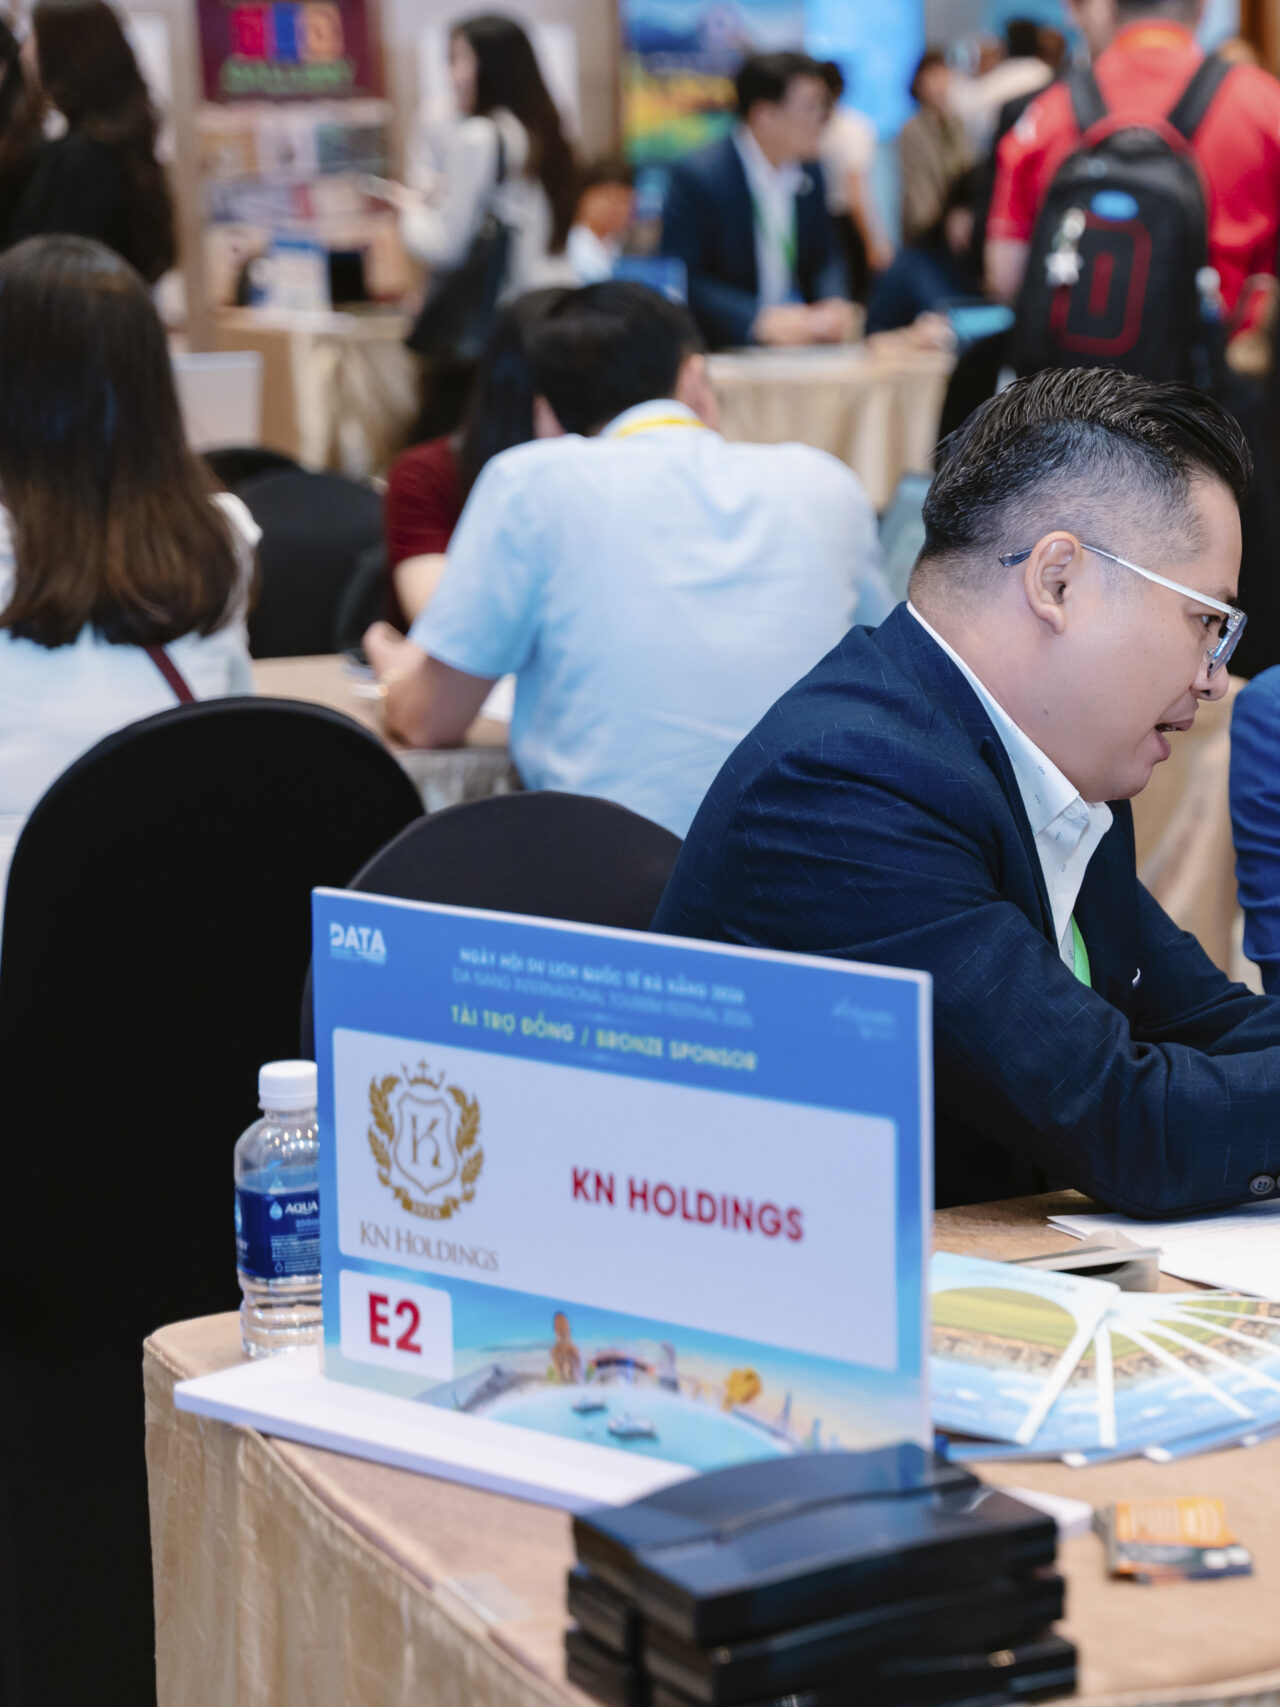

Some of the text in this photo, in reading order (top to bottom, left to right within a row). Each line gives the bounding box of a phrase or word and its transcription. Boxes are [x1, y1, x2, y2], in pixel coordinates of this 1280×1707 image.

[330, 922, 387, 953] DATA
[527, 957, 546, 975] DU
[452, 1001, 477, 1028] TÀI
[483, 1009, 516, 1036] TRỢ
[521, 1010, 575, 1041] ĐỒNG
[596, 1028, 663, 1059] BRONZE
[669, 1039, 758, 1072] SPONSOR
[412, 1113, 443, 1169] K
[571, 1164, 805, 1244] KN HOLDINGS
[359, 1221, 391, 1248] KN
[368, 1290, 422, 1356] E2
